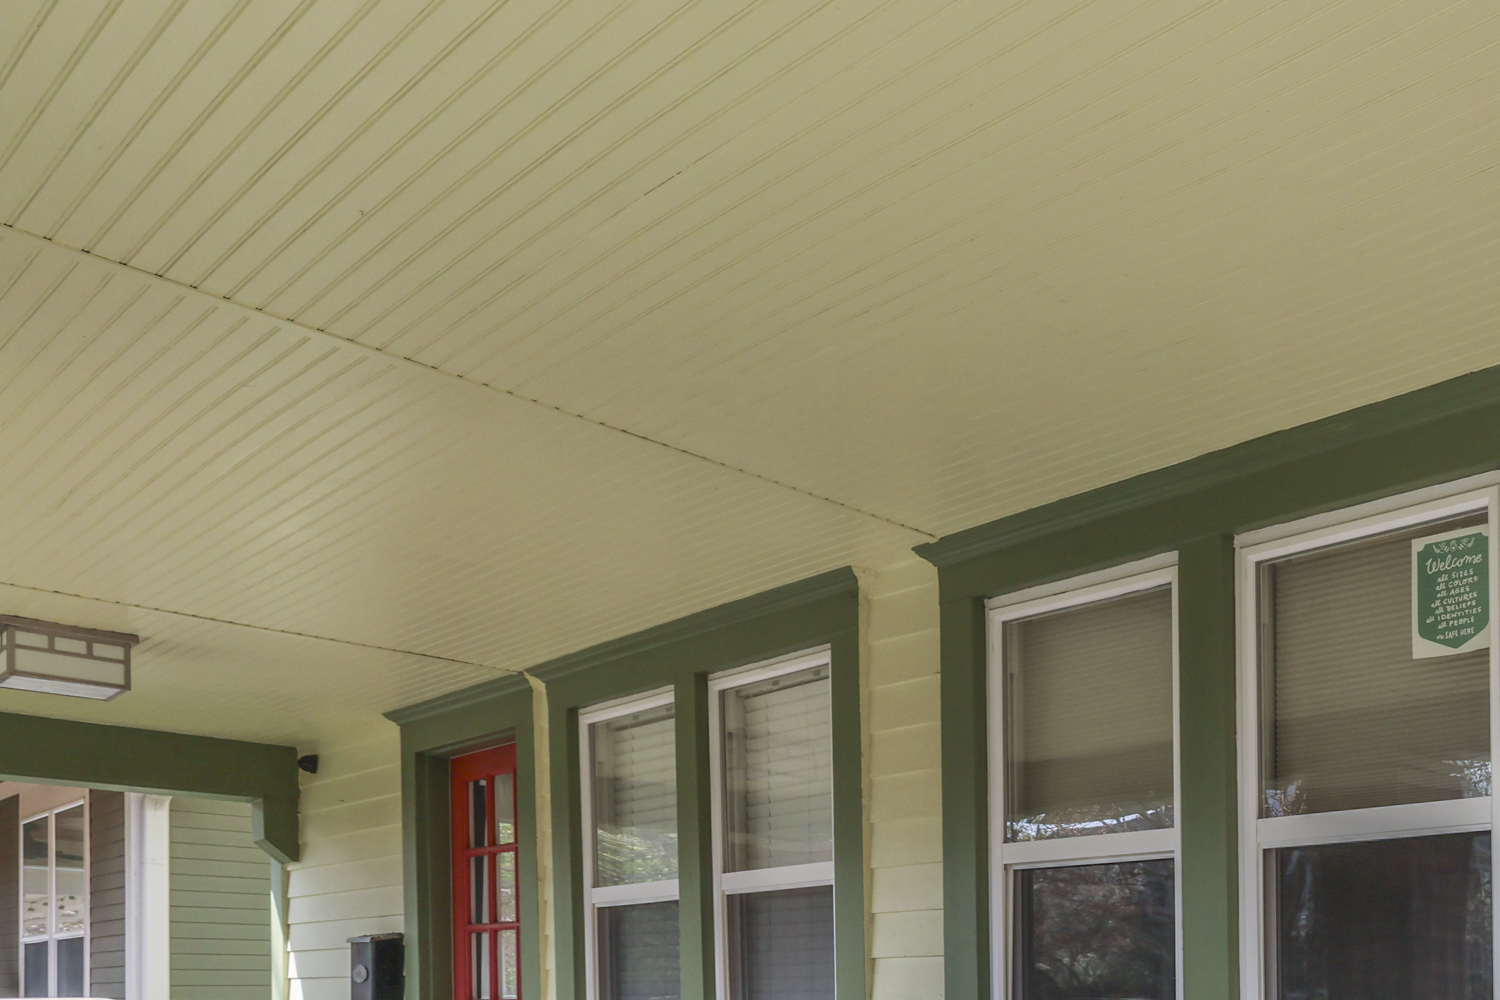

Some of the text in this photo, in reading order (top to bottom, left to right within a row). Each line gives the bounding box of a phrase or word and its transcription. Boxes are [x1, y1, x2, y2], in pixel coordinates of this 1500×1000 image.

[1426, 553, 1482, 575] Welcome
[1452, 569, 1474, 579] SIZES
[1448, 576, 1478, 588] COLORS
[1450, 586, 1470, 595] AGES
[1443, 591, 1477, 605] CULTURES
[1447, 600, 1476, 612] BELIEFS
[1438, 607, 1481, 621] IDENTITIES
[1449, 616, 1474, 627] PEOPLE
[1445, 629, 1458, 640] SAFE
[1460, 627, 1474, 637] HERE
